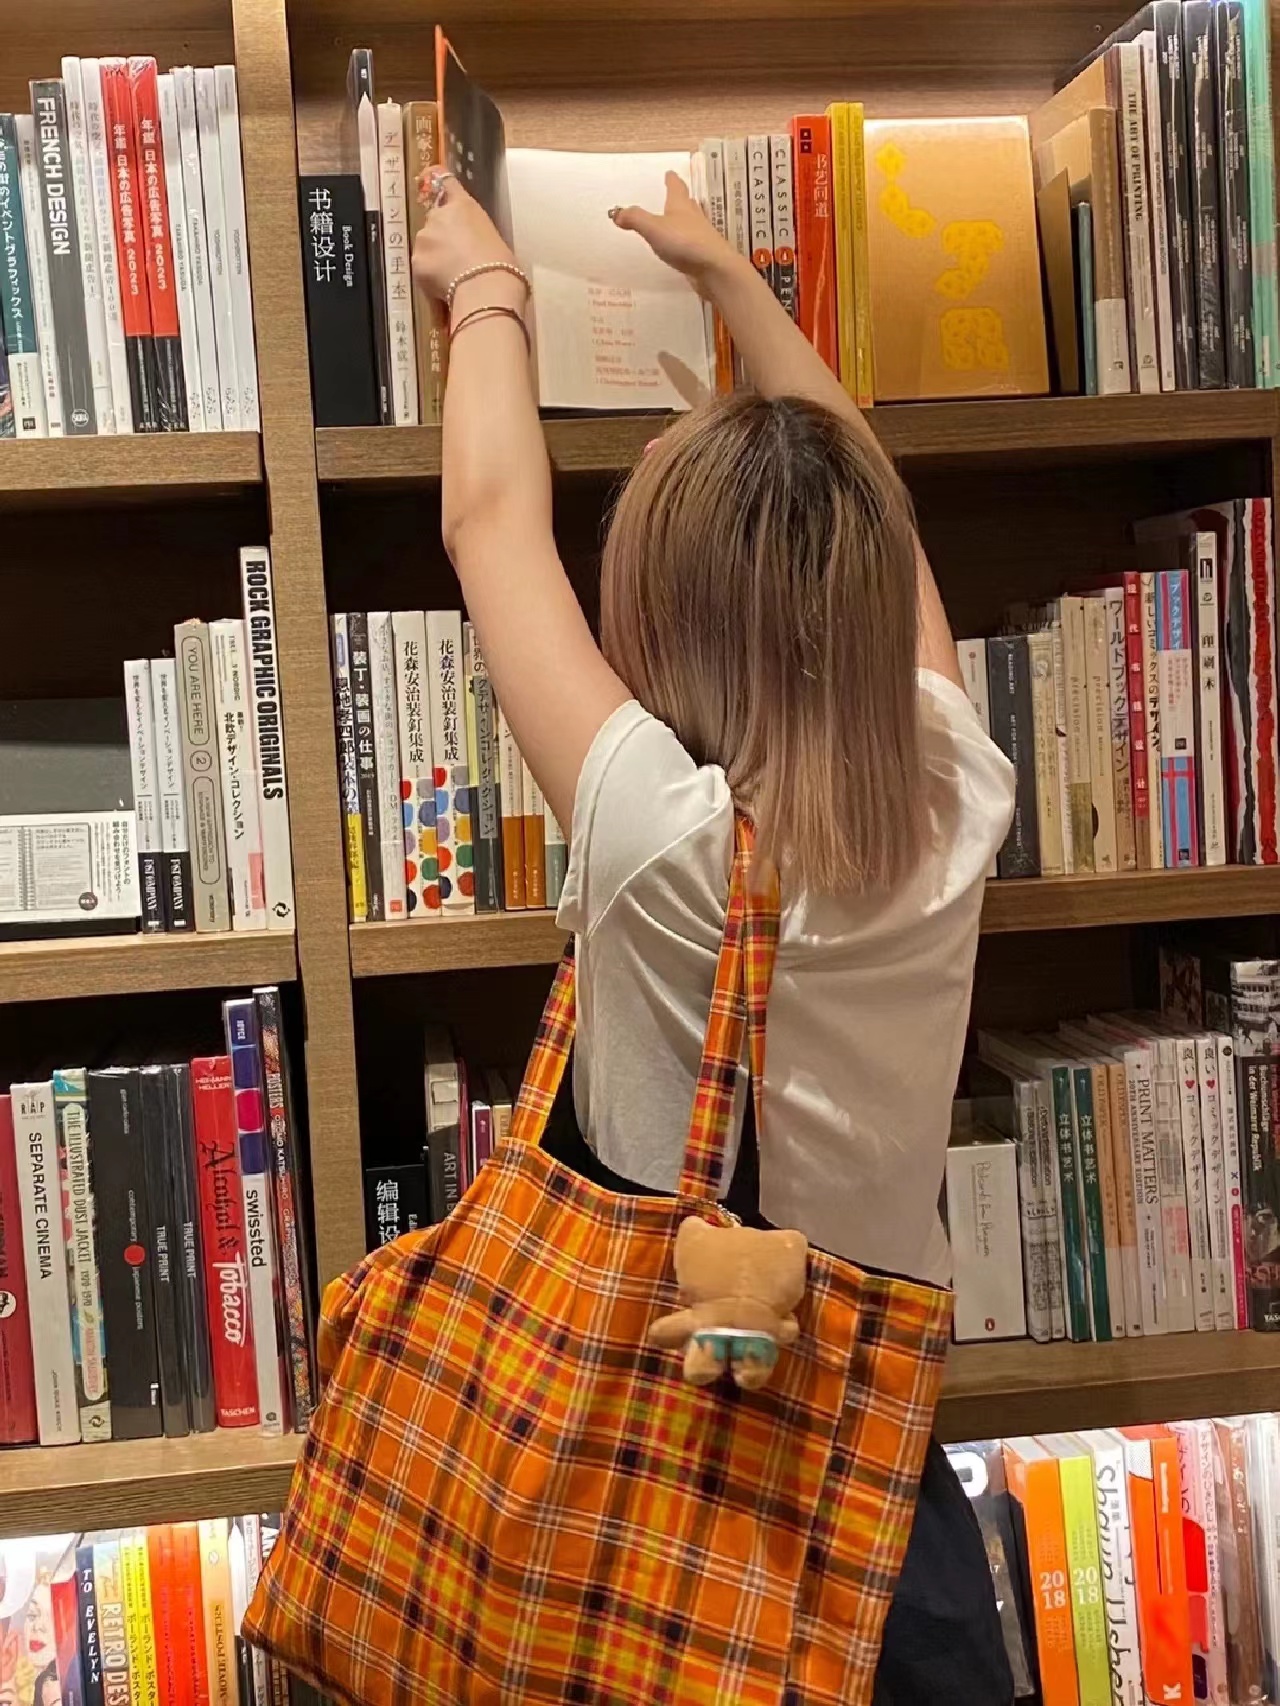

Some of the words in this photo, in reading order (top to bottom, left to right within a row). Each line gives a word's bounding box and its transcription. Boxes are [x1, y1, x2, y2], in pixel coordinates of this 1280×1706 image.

[1128, 92, 1138, 115] THE
[37, 98, 63, 179] FRENCH
[142, 119, 156, 144] 年鑑
[1129, 121, 1139, 141] ART
[1130, 146, 1141, 161] OF
[117, 154, 137, 243] 日本の広告写真
[144, 150, 164, 238] 日本の広告写真
[752, 151, 767, 239] CLASSIC
[775, 148, 790, 237] CLASSIC
[813, 153, 830, 218] 书艺问道
[1131, 164, 1143, 222] PRINTING
[47, 183, 71, 255] DESIGN
[384, 131, 408, 299] デザインの手本
[308, 187, 337, 283] 书籍设计
[342, 225, 353, 250] Book
[126, 248, 139, 295] 2023
[155, 243, 168, 290] 2023
[342, 253, 354, 288] Design
[245, 560, 271, 612] ROCK
[187, 647, 198, 672] YOU
[250, 616, 277, 699] GRAPHIC
[190, 676, 202, 700] ARE
[1108, 600, 1129, 772] ワールドブックデザイン
[192, 702, 204, 735] HERE
[195, 756, 207, 765] 2
[257, 701, 284, 800] ORIGINALS
[1182, 1047, 1194, 1075] 良い
[1203, 1047, 1216, 1075] 良い
[267, 1073, 284, 1109] POSTERS
[1138, 1079, 1153, 1128] PRINT
[67, 1111, 80, 1131] THE
[274, 1115, 286, 1146] OTOMO
[68, 1132, 86, 1196] ILLUSTRATED
[443, 1152, 457, 1179] ART
[1080, 1114, 1097, 1184] 立体书艺术
[28, 1131, 49, 1214] SEPARATE
[200, 1141, 241, 1232] Alcohol
[1141, 1131, 1160, 1205] MATTERS
[445, 1182, 458, 1199] IN
[73, 1198, 89, 1226] DUST
[128, 1189, 138, 1242] contemporary
[245, 1189, 267, 1268] swissted
[376, 1179, 401, 1246] 编辑设
[36, 1217, 53, 1280] CINEMA
[75, 1226, 91, 1263] JACKET
[156, 1225, 168, 1252] TRUE
[183, 1221, 195, 1246] TRUE
[158, 1253, 170, 1283] PRINT
[185, 1247, 197, 1279] PRINT
[131, 1265, 143, 1300] japanese
[213, 1252, 247, 1348] Tobacco
[135, 1300, 144, 1330] posters
[220, 1407, 255, 1417] TASCHEN
[1096, 1464, 1118, 1581] Shaun
[83, 1569, 93, 1593] TO
[1040, 1569, 1065, 1590] 20
[1073, 1566, 1098, 1586] 20
[1043, 1591, 1067, 1611] 18
[1077, 1586, 1100, 1606] 18
[86, 1605, 99, 1685] EVELYN
[102, 1602, 127, 1668] RETRO
